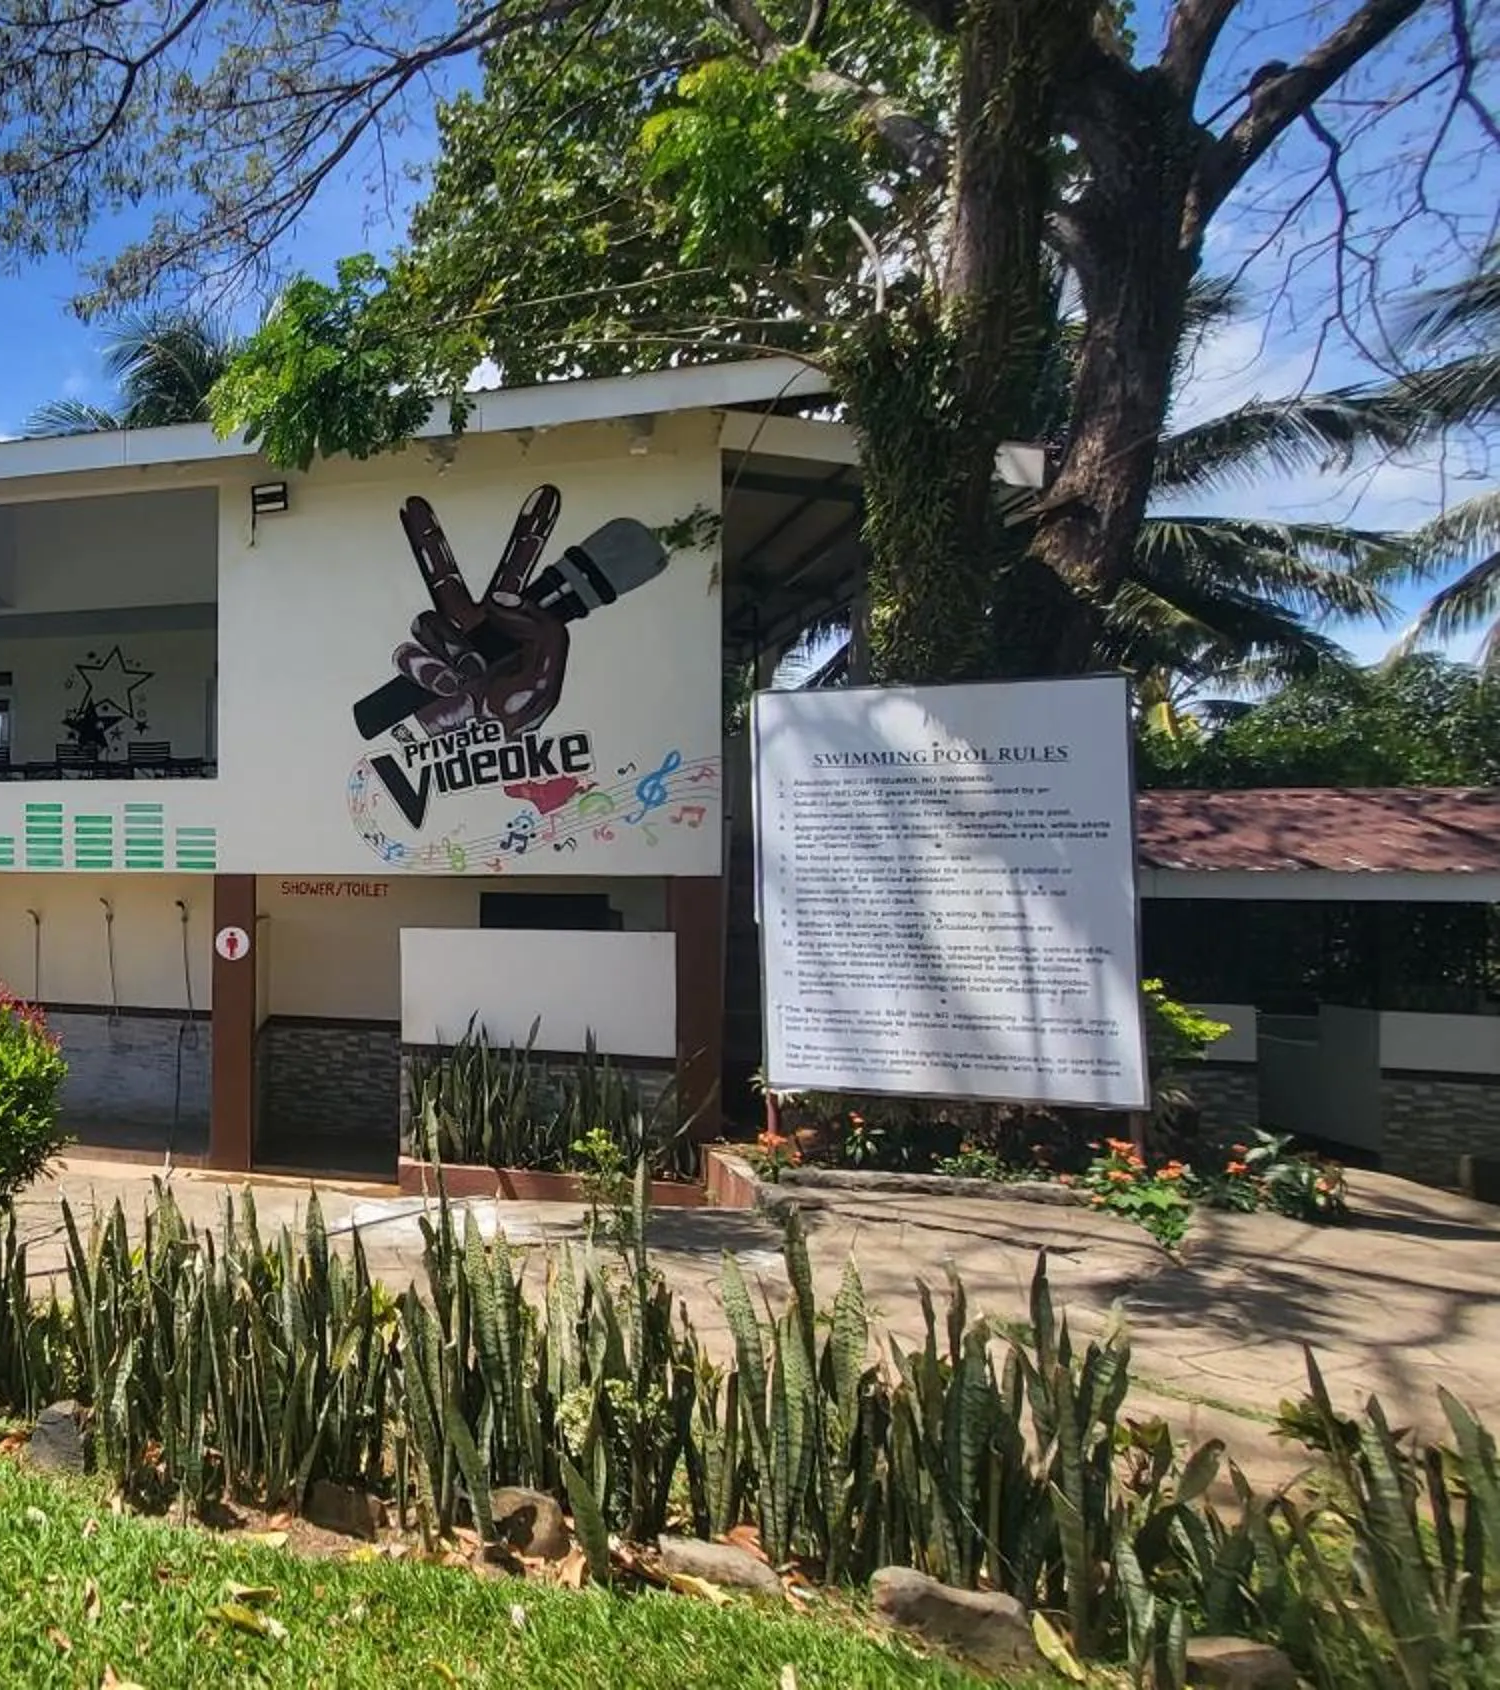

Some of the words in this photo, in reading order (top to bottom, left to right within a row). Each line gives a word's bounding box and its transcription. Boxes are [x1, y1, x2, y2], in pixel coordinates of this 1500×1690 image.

[812, 751, 928, 766] SWIMMING
[933, 747, 990, 763] POOL
[998, 745, 1070, 761] RULES
[280, 880, 389, 897] SHOWER/TOILET
